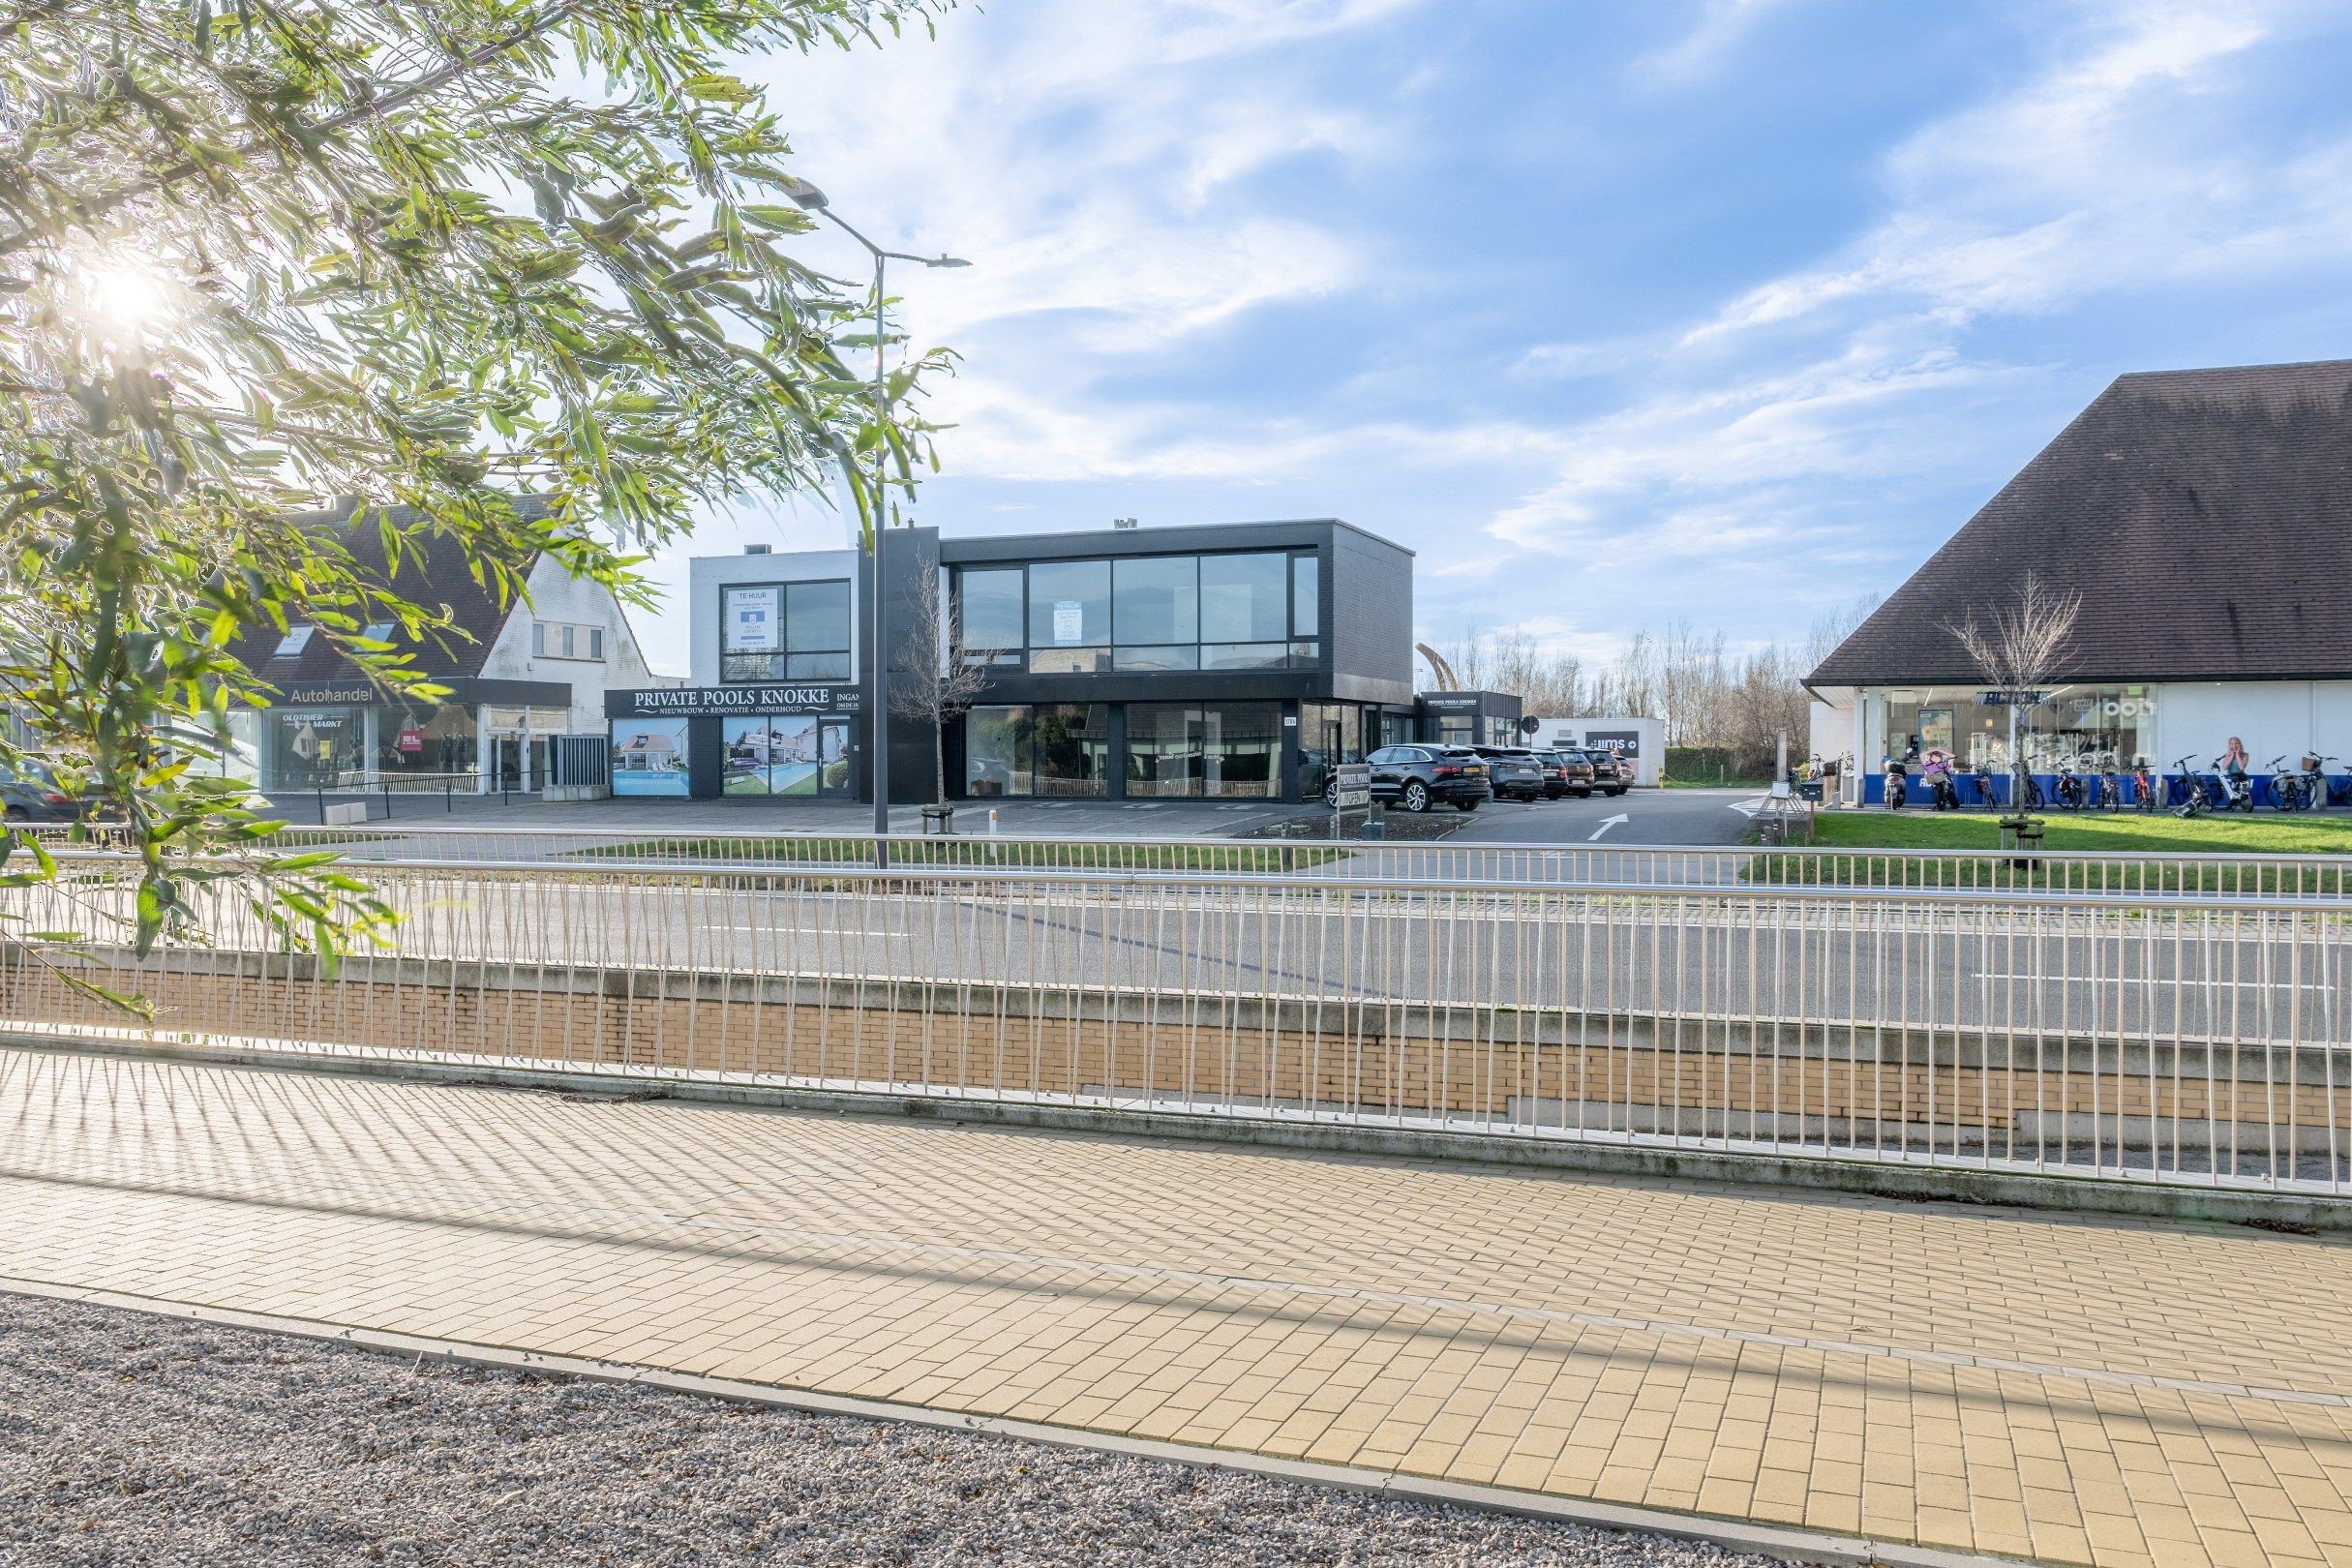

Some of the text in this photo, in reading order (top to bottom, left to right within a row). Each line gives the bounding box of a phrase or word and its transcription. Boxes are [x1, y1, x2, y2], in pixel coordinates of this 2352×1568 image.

[290, 687, 373, 703] Autohandel
[634, 688, 829, 707] PRIVATE POOLS KNOKKE
